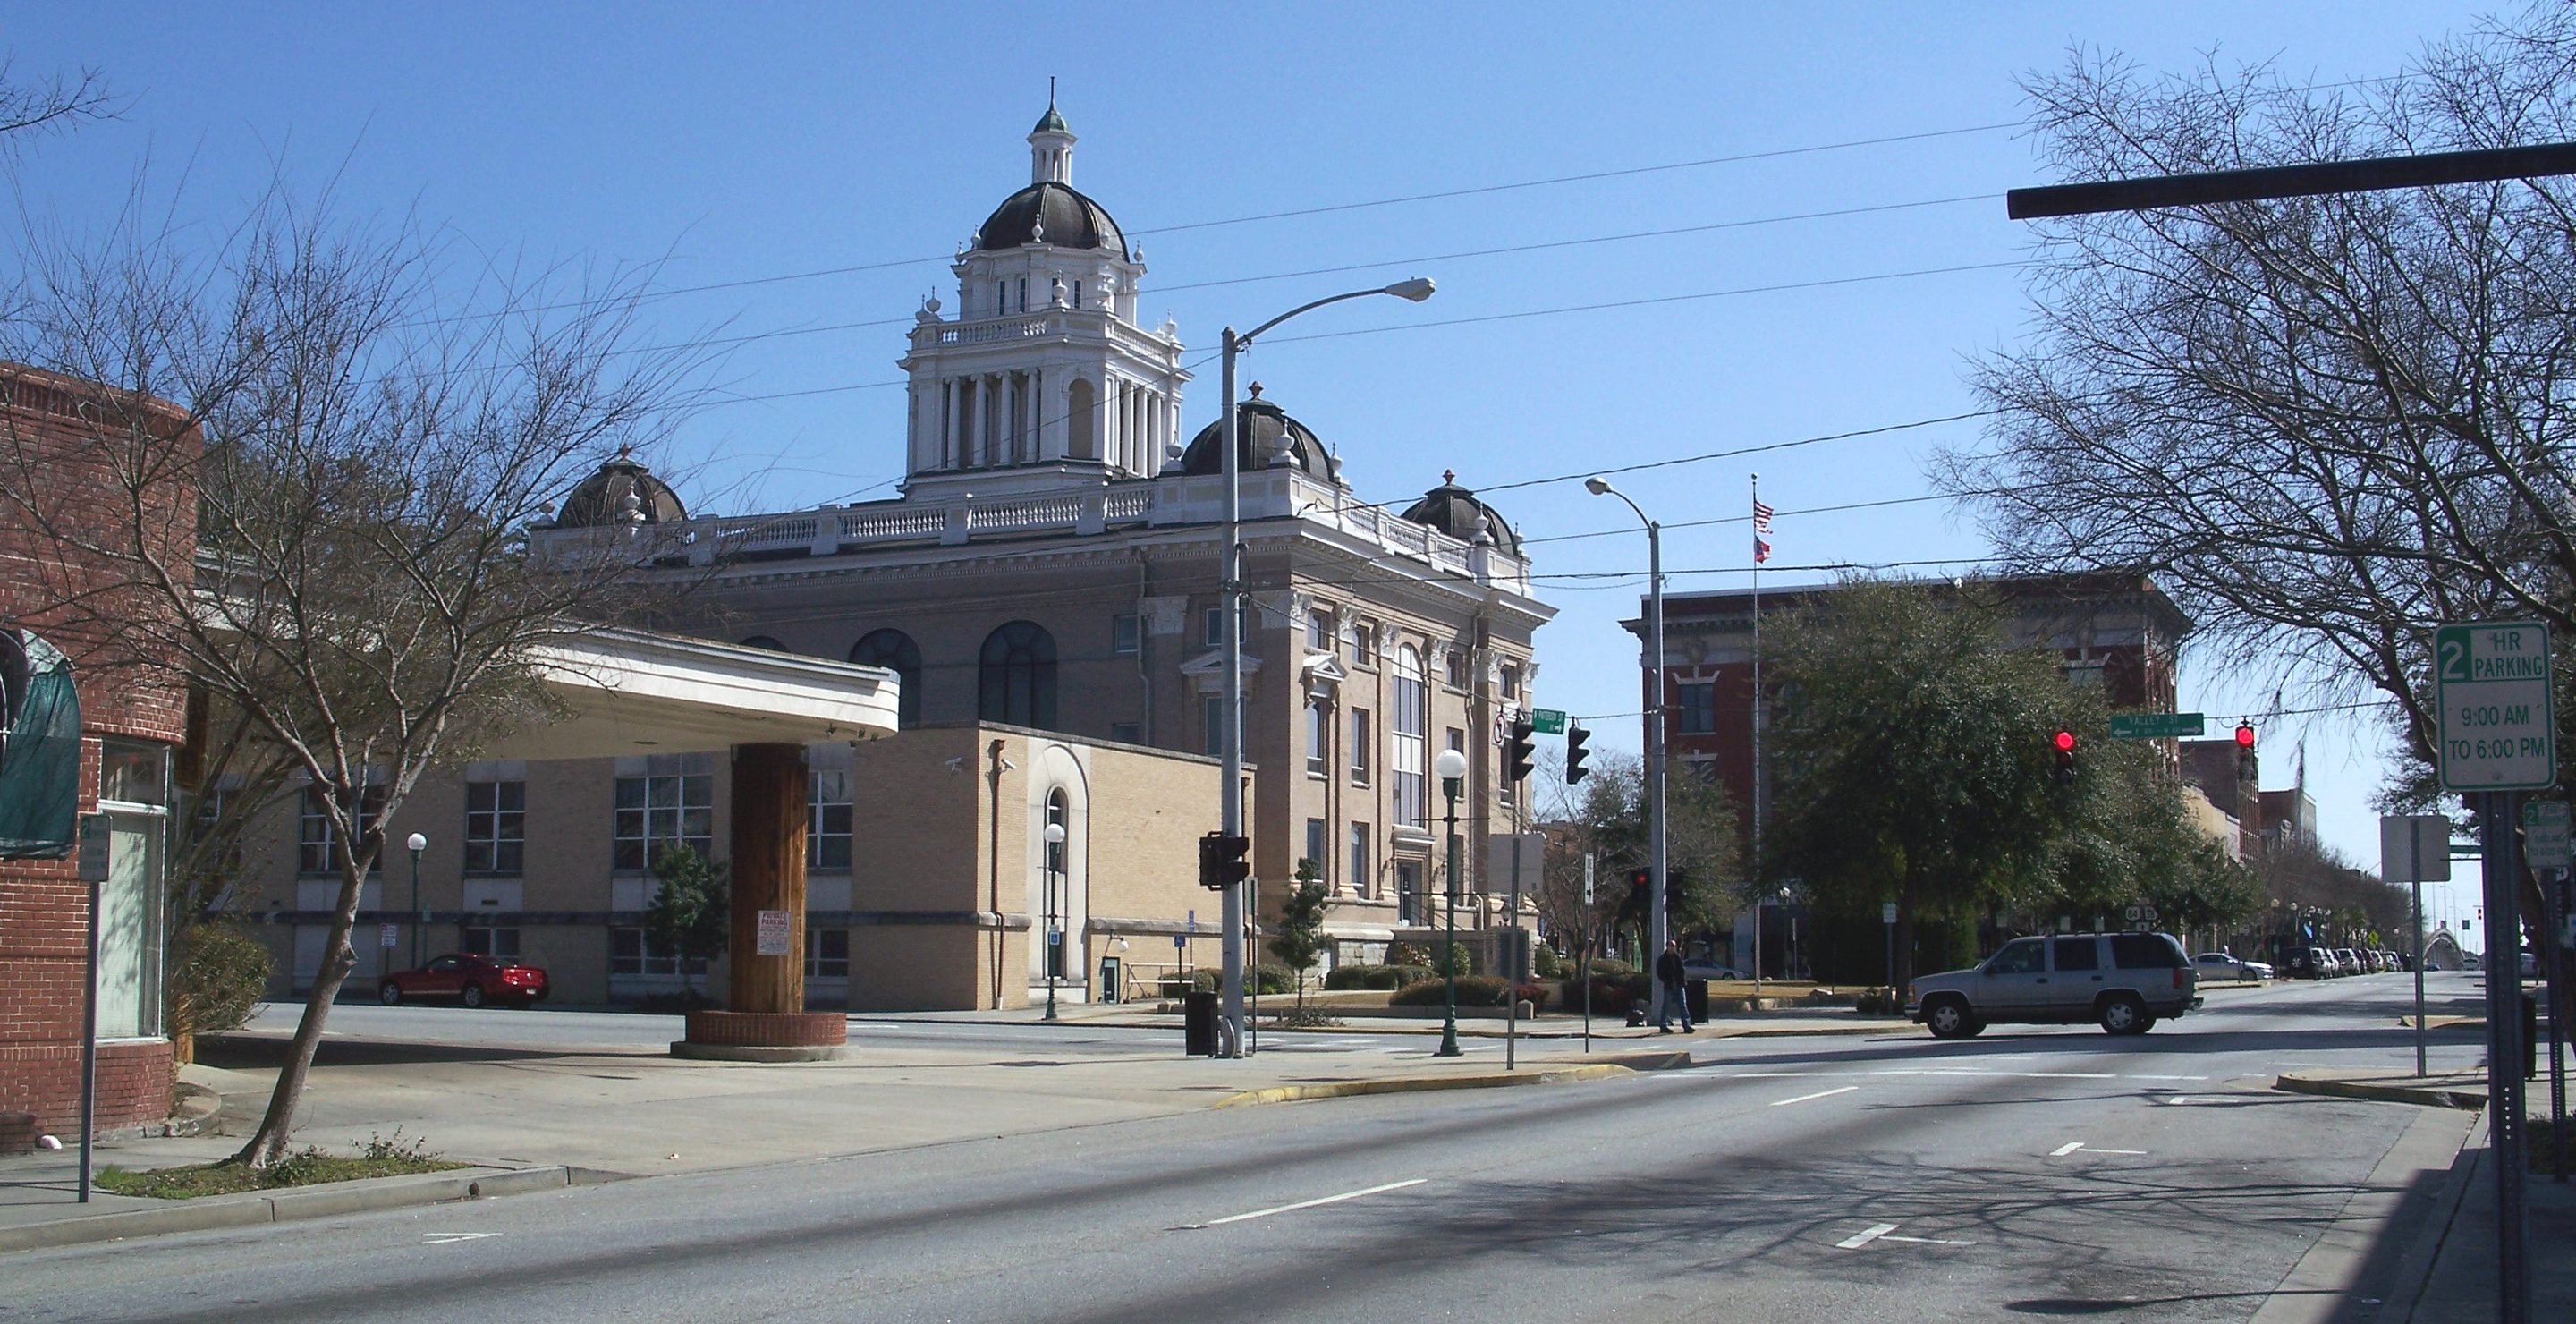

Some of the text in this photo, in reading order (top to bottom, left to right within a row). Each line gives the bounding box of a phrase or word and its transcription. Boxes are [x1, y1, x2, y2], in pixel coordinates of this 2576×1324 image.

[2494, 631, 2521, 652] HR
[2440, 640, 2466, 680] 2
[2474, 656, 2543, 678] PARKING
[2128, 715, 2179, 726] VALLEY ST
[2462, 704, 2529, 726] 9:00 AM
[2448, 736, 2546, 760] TO 6:00 PM
[2526, 809, 2536, 825] 2
